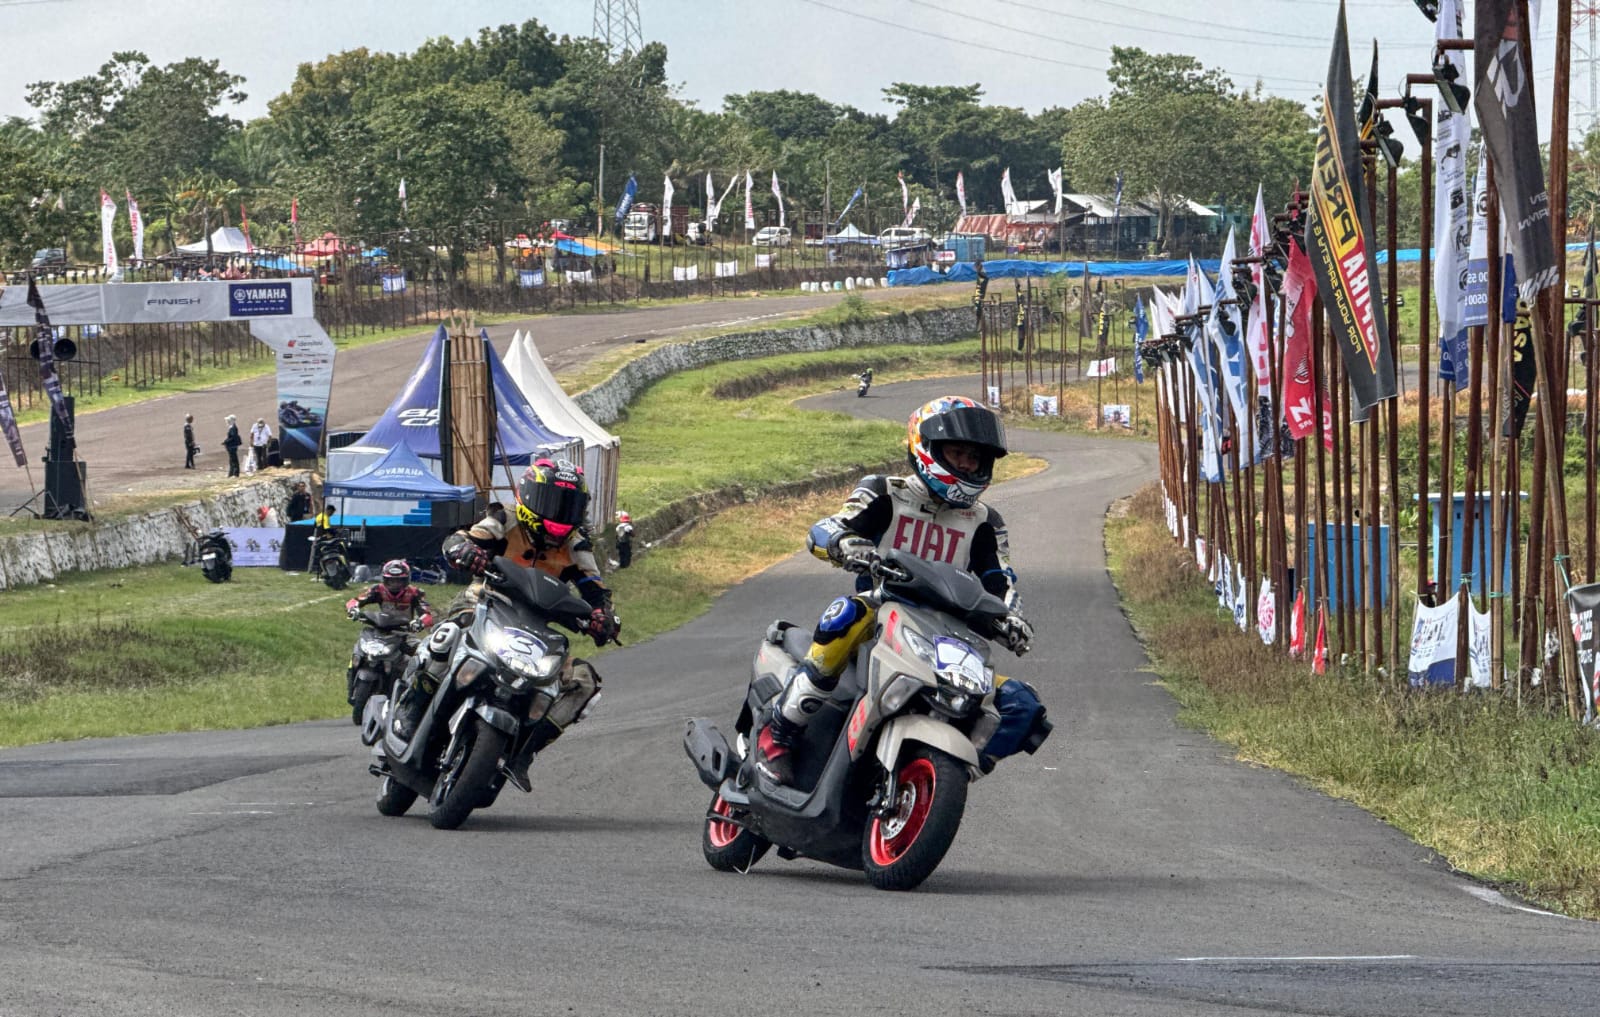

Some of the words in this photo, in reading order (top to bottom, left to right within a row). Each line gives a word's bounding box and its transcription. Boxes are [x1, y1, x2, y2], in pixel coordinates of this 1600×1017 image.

[246, 288, 287, 299] YAMAHA
[385, 467, 424, 476] YAMAHA
[893, 514, 966, 564] FIAT
